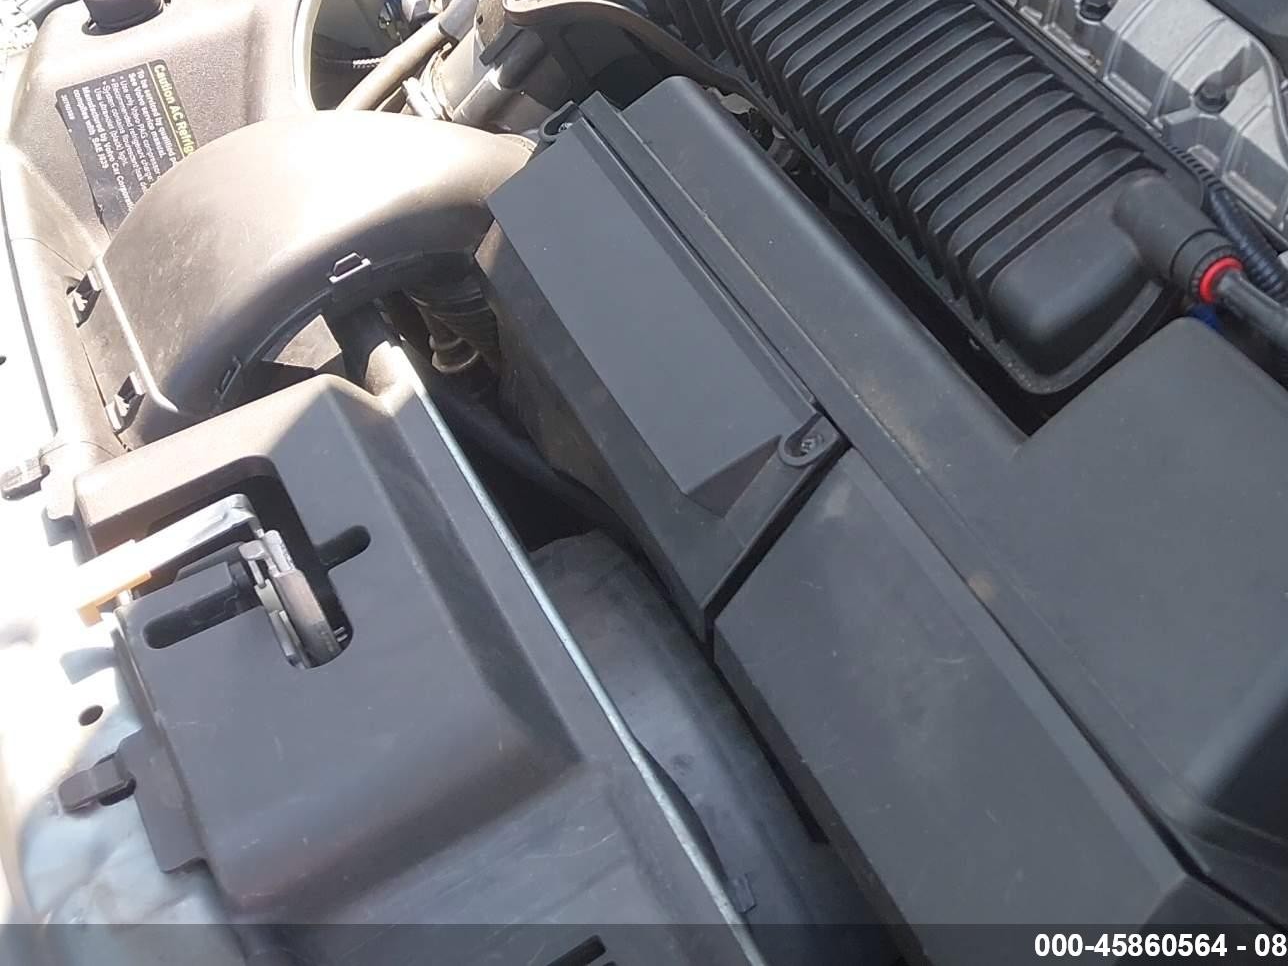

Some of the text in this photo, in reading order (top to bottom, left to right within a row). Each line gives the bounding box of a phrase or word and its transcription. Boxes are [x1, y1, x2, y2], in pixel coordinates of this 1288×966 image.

[73, 89, 89, 120] complies
[85, 119, 95, 136] with
[82, 86, 104, 133] Manufactured
[103, 142, 115, 162] Volvo
[99, 101, 113, 130] ultraviolet
[109, 130, 123, 151] (black)
[101, 85, 114, 108] System
[111, 108, 124, 134] contains
[111, 82, 133, 127] Recommended
[128, 128, 144, 159] refrigerant
[125, 93, 134, 106] only
[131, 106, 140, 124] Volvo
[142, 139, 159, 174] compressor
[134, 86, 145, 106] Volvo
[141, 107, 153, 130] service
[151, 131, 166, 158] manual.
[144, 89, 159, 116] serviced
[158, 127, 174, 156] qualified
[154, 64, 175, 104] Caution
[176, 121, 195, 156] Refrig
